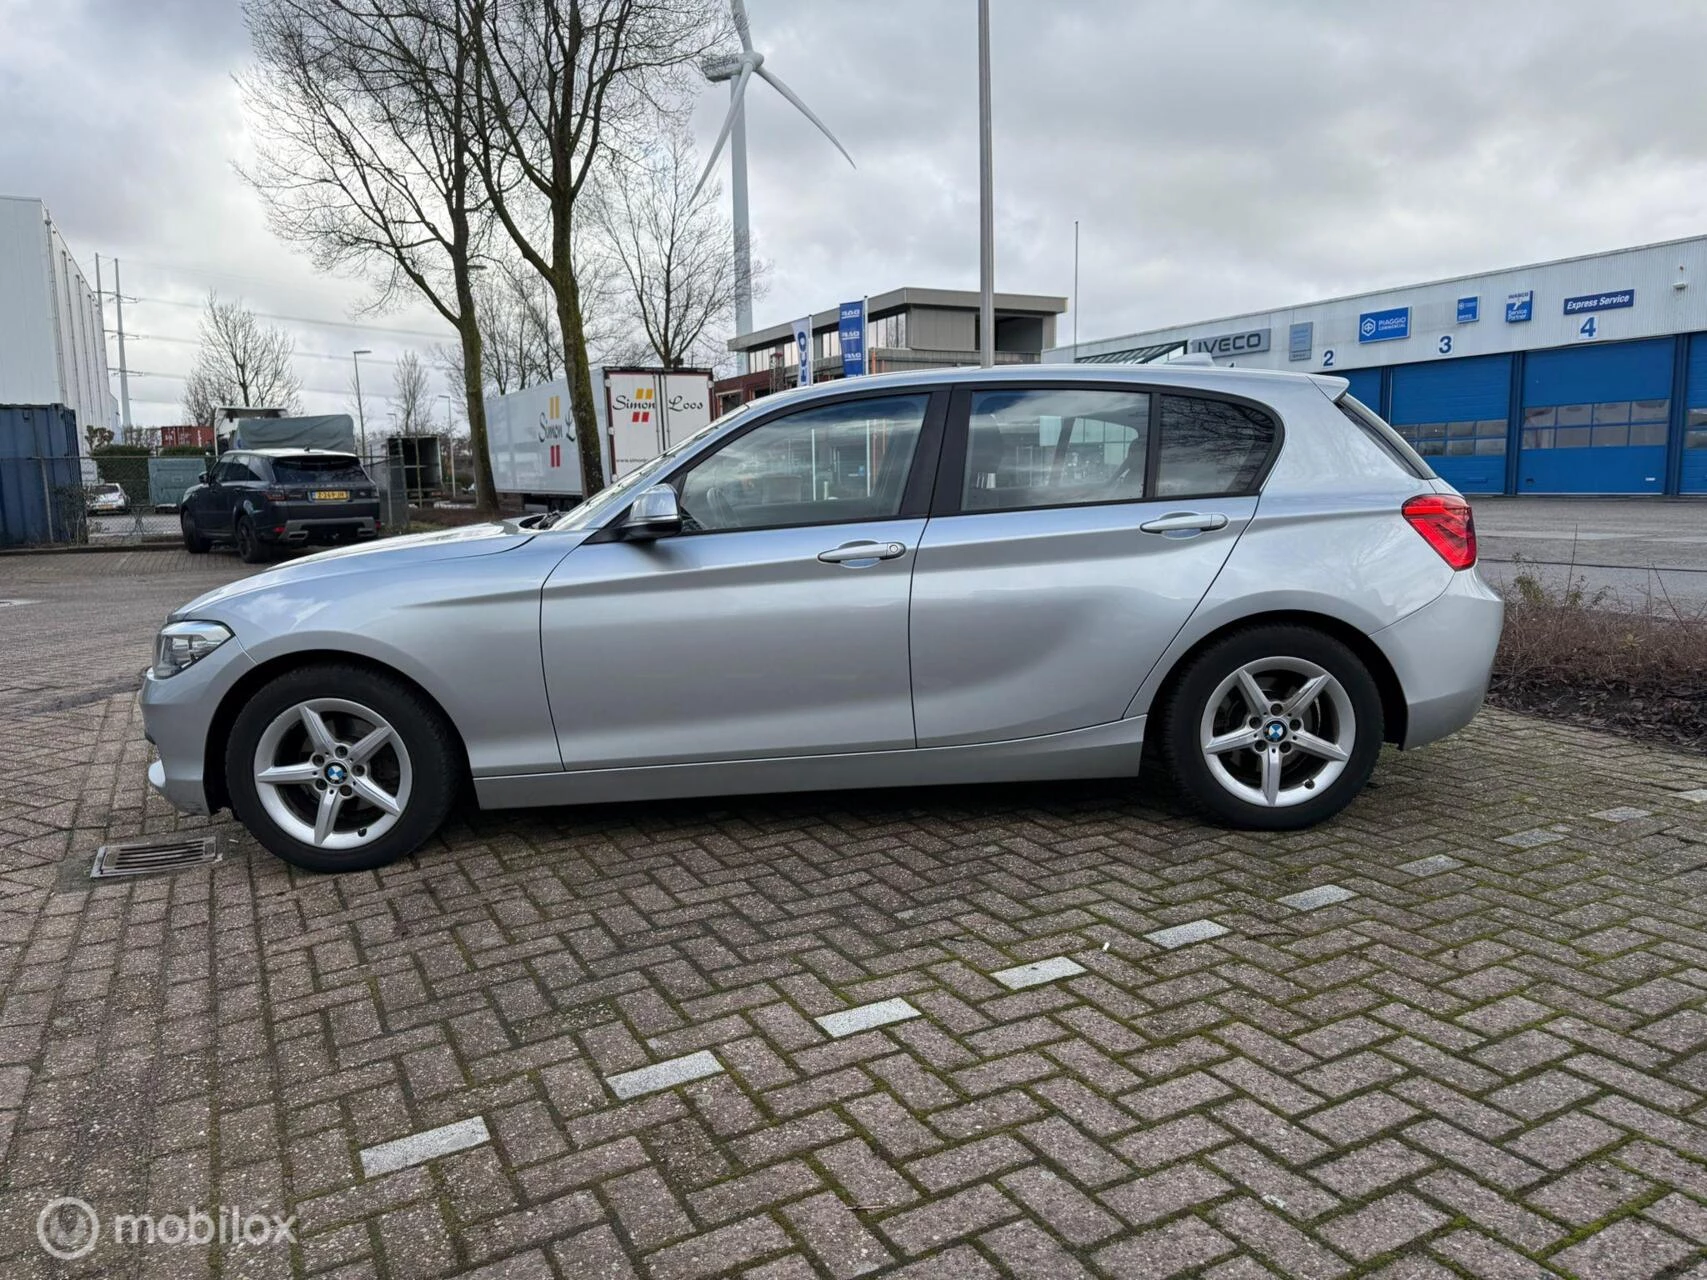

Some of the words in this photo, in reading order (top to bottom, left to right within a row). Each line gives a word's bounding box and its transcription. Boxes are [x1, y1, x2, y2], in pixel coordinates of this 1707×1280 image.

[1567, 299, 1598, 310] Express
[1599, 295, 1630, 306] Service
[1378, 316, 1406, 325] PIAGGIO
[1580, 316, 1596, 337] 4
[1198, 333, 1261, 353] IVECO
[1439, 335, 1452, 353] 3
[1323, 350, 1334, 367] 2
[612, 394, 657, 411] Simon
[668, 395, 704, 412] Loos
[538, 411, 563, 443] Simon
